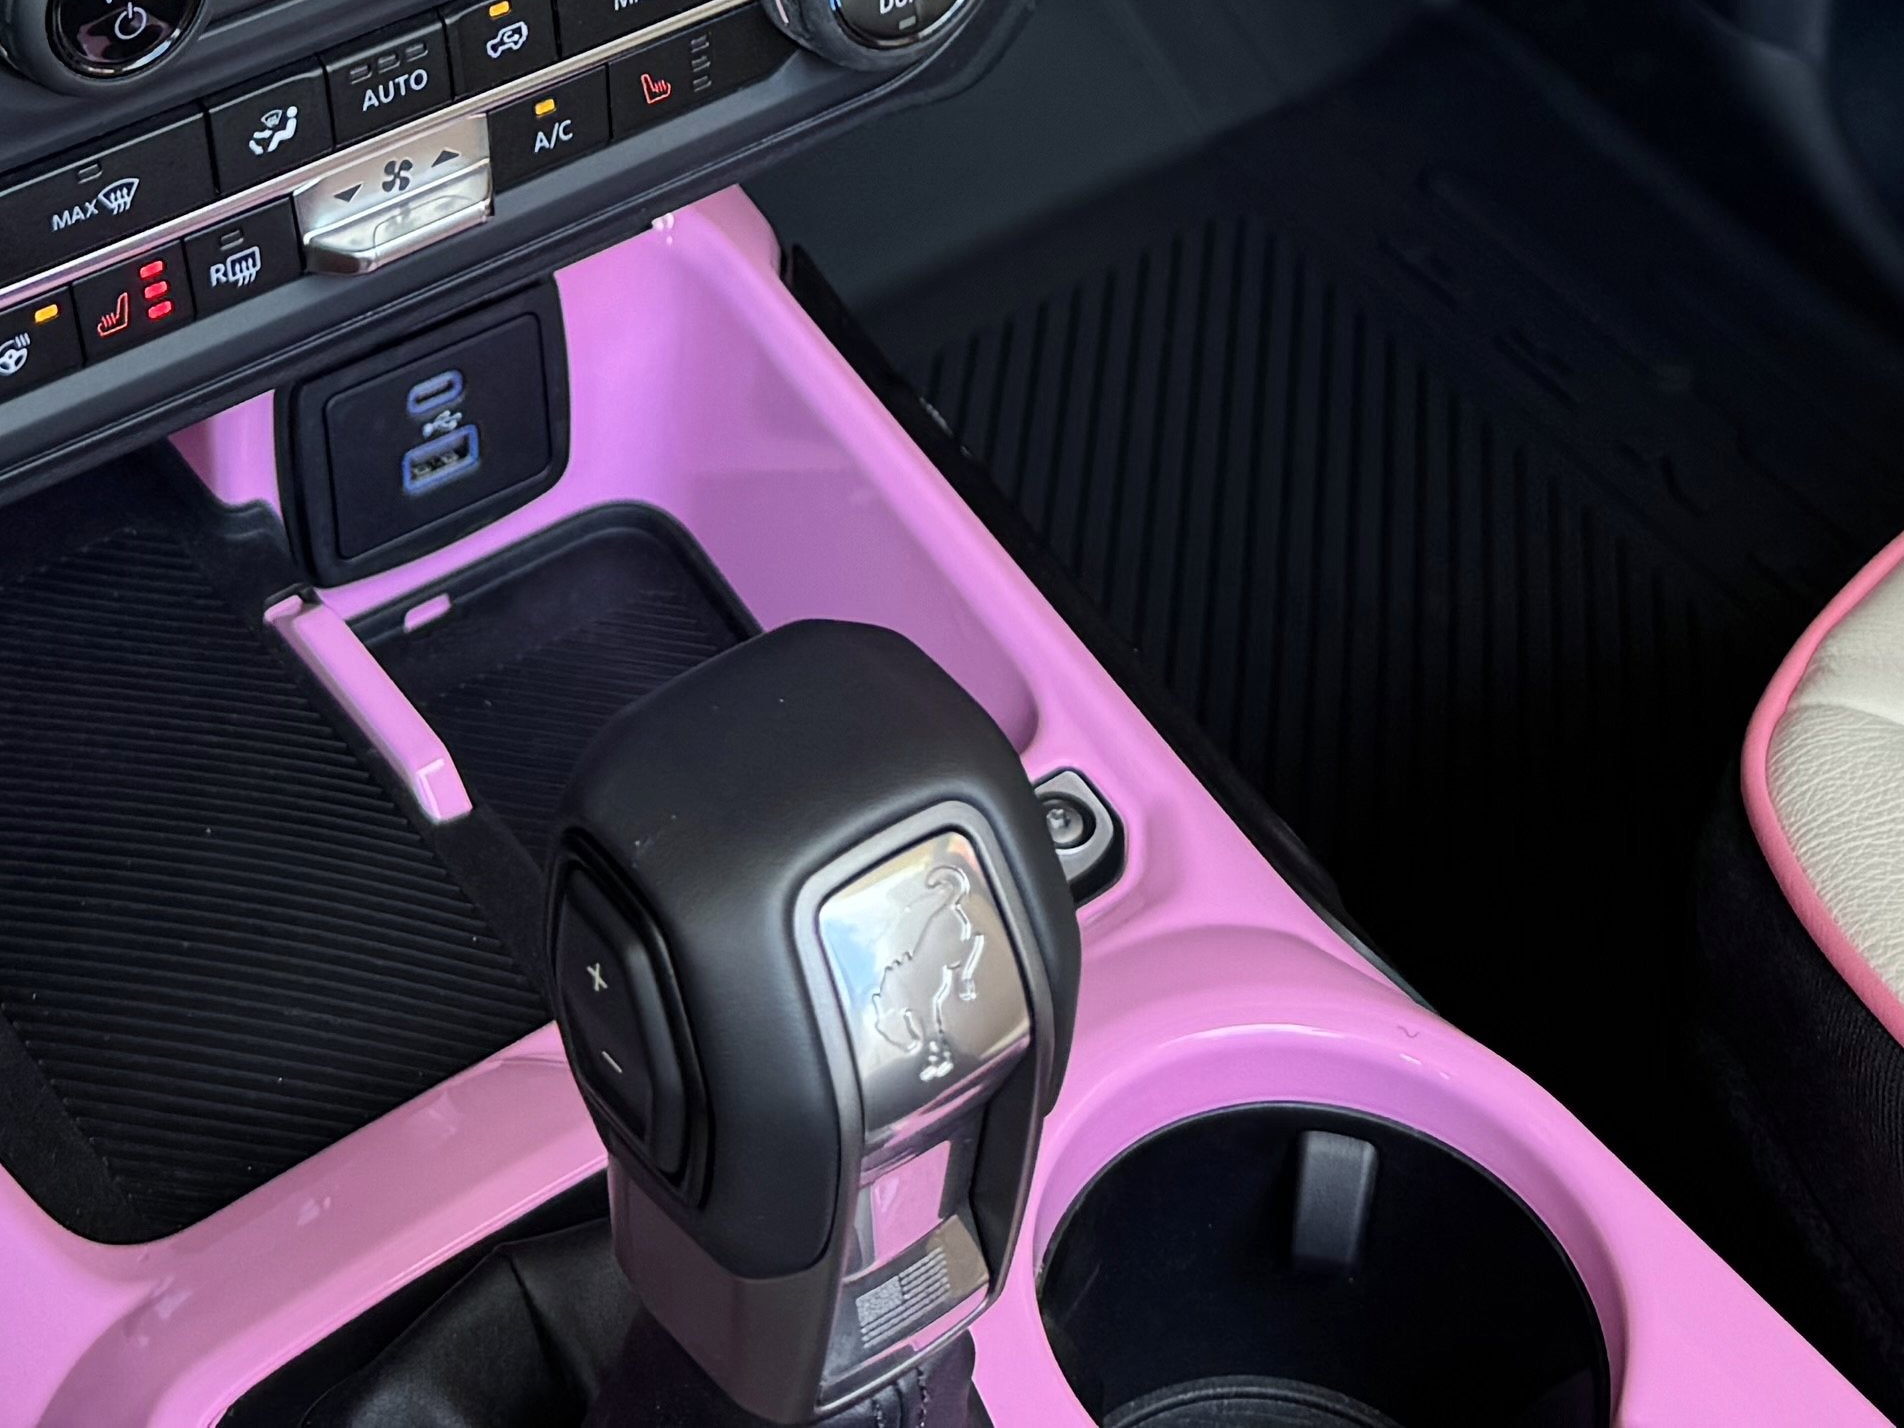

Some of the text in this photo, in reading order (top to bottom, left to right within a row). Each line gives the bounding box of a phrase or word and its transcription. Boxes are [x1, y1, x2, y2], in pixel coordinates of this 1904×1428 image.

[362, 68, 428, 112] AUTO
[534, 119, 574, 153] A/C
[51, 201, 99, 231] MAX
[209, 265, 227, 287] R
